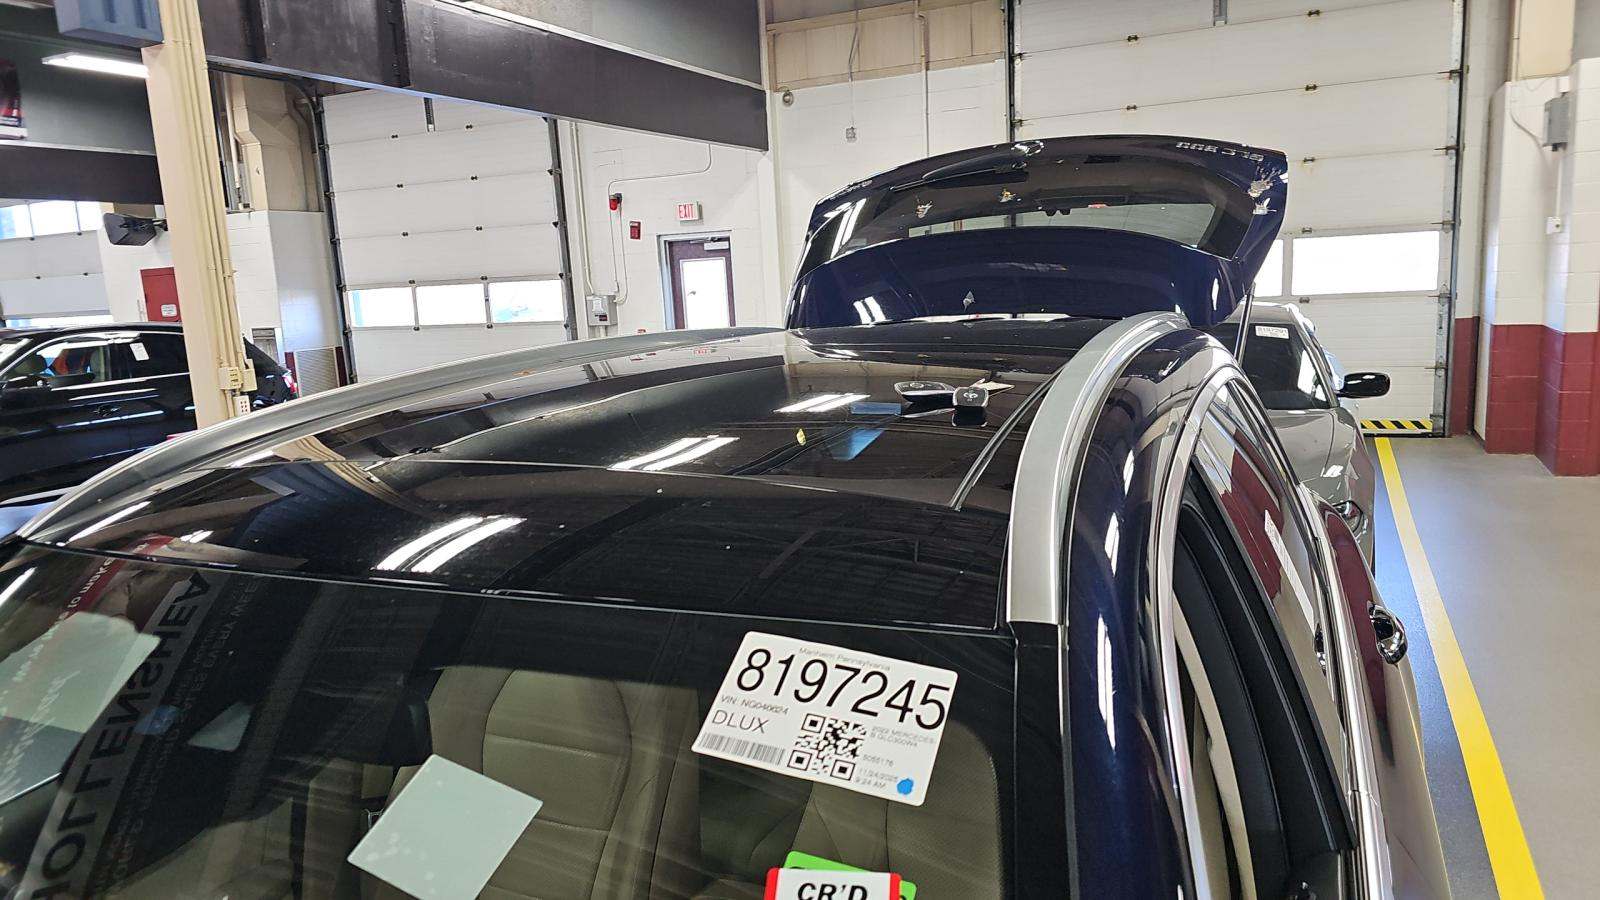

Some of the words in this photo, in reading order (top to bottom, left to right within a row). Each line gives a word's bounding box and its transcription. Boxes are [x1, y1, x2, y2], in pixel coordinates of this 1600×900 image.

[678, 203, 694, 219] EXIT
[836, 653, 891, 671] Pennsylvania
[736, 647, 950, 731] 8197245
[711, 709, 771, 735] DLUX
[797, 882, 868, 900] CR'D
